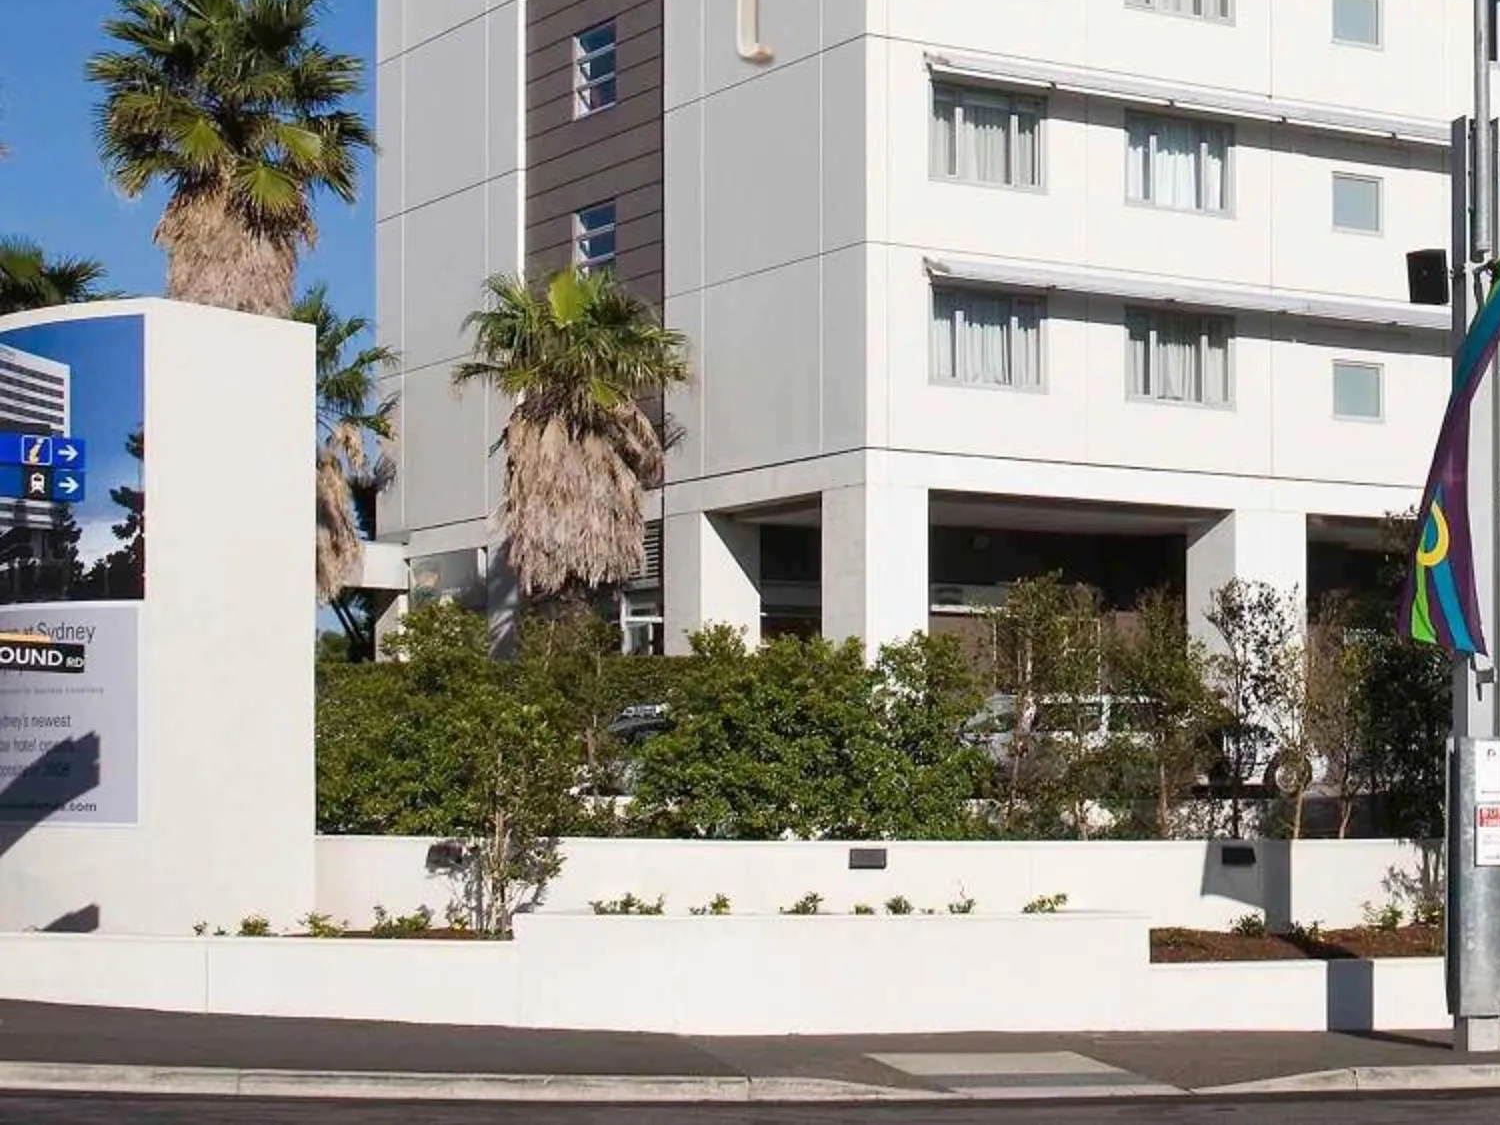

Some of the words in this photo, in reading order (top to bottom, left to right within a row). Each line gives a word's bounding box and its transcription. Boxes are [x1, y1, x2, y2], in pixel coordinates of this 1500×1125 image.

[36, 621, 97, 644] Sydney
[0, 646, 63, 666] OUND
[66, 656, 85, 668] RD
[31, 715, 72, 728] newest
